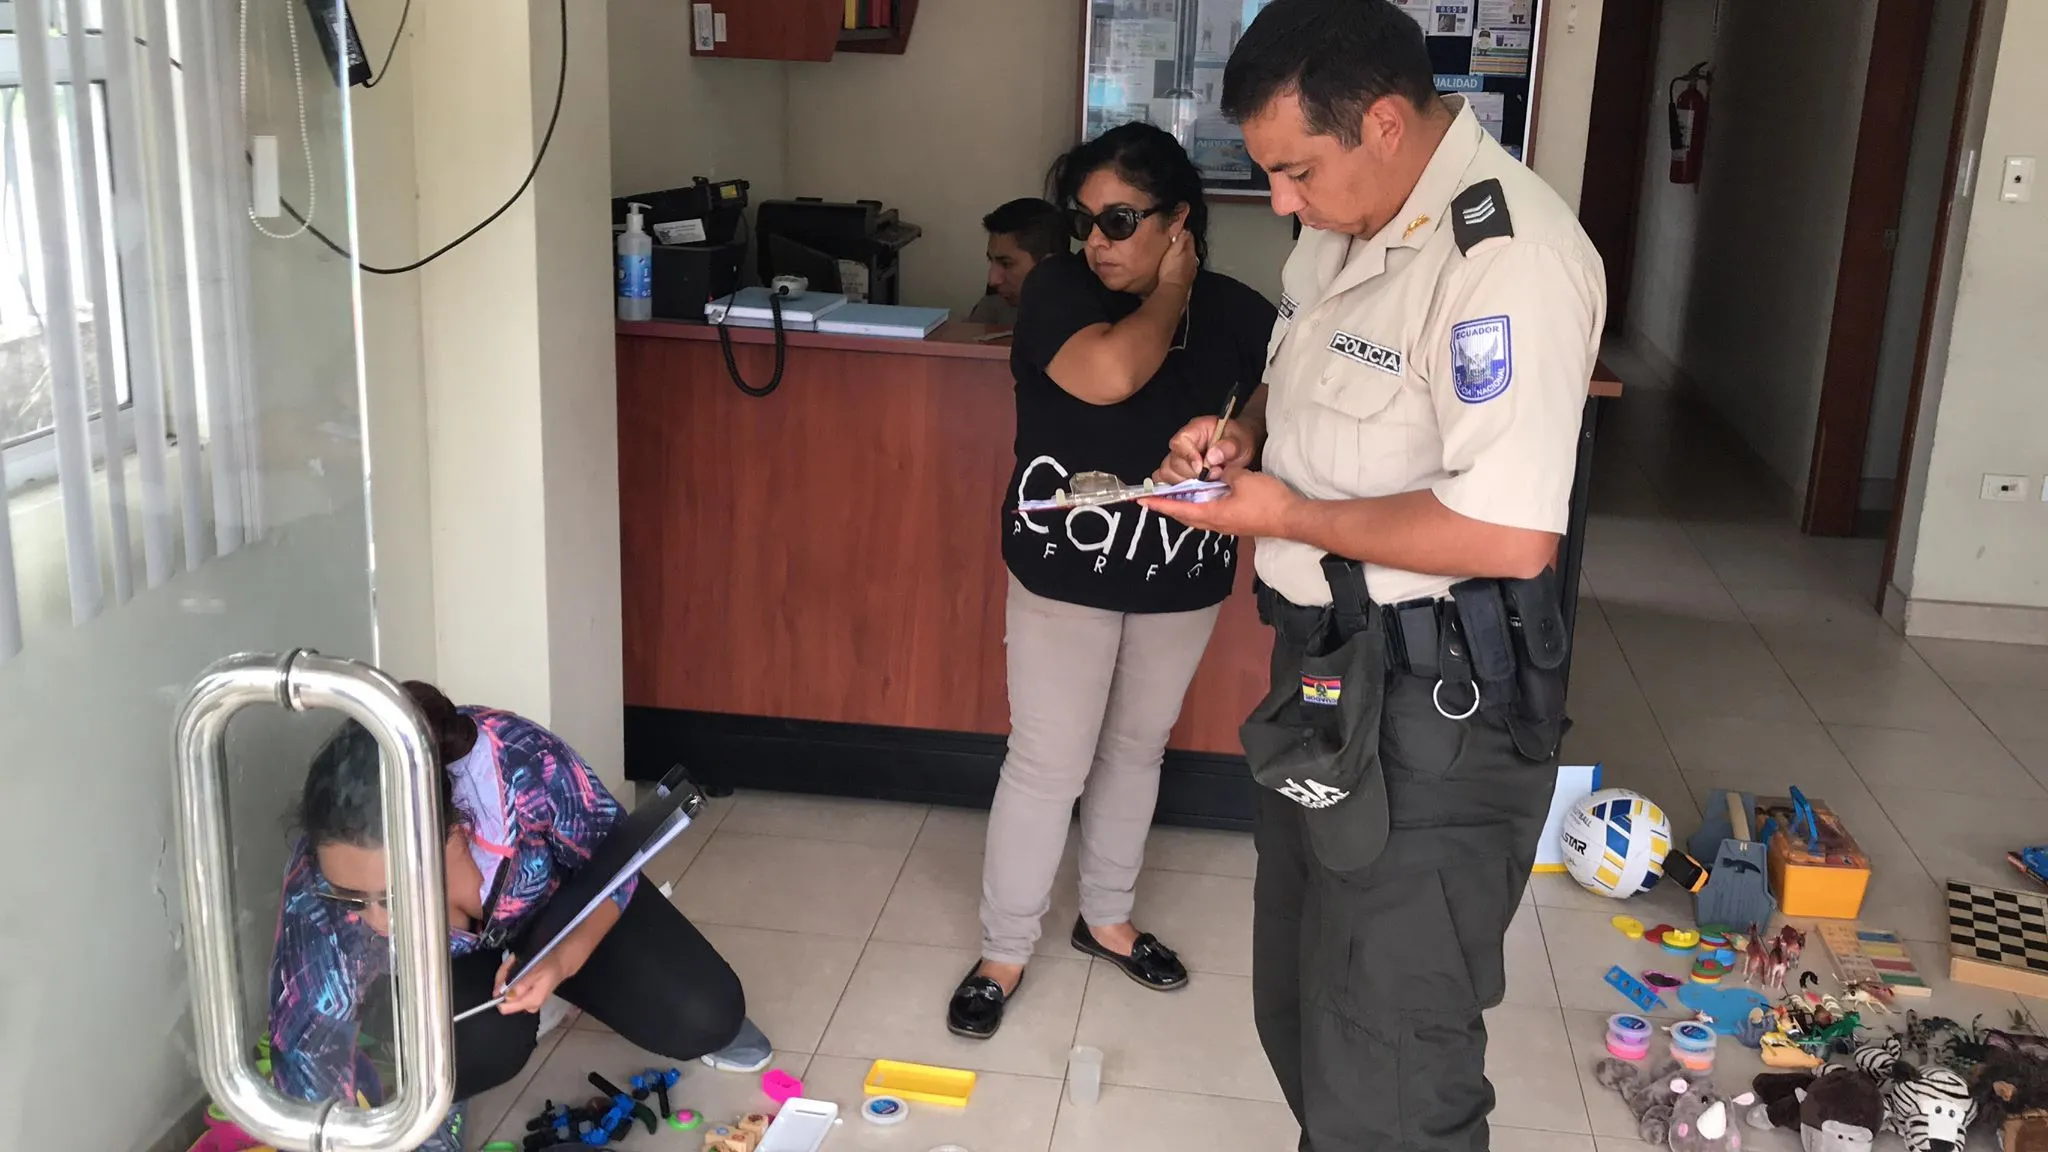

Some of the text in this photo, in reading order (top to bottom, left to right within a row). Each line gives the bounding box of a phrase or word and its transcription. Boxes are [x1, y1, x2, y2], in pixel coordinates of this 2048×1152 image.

[1433, 77, 1478, 89] UALIDAD
[1456, 326, 1500, 340] ECUADOR
[1331, 335, 1399, 371] POLICIA
[1476, 366, 1505, 397] NACIONAL
